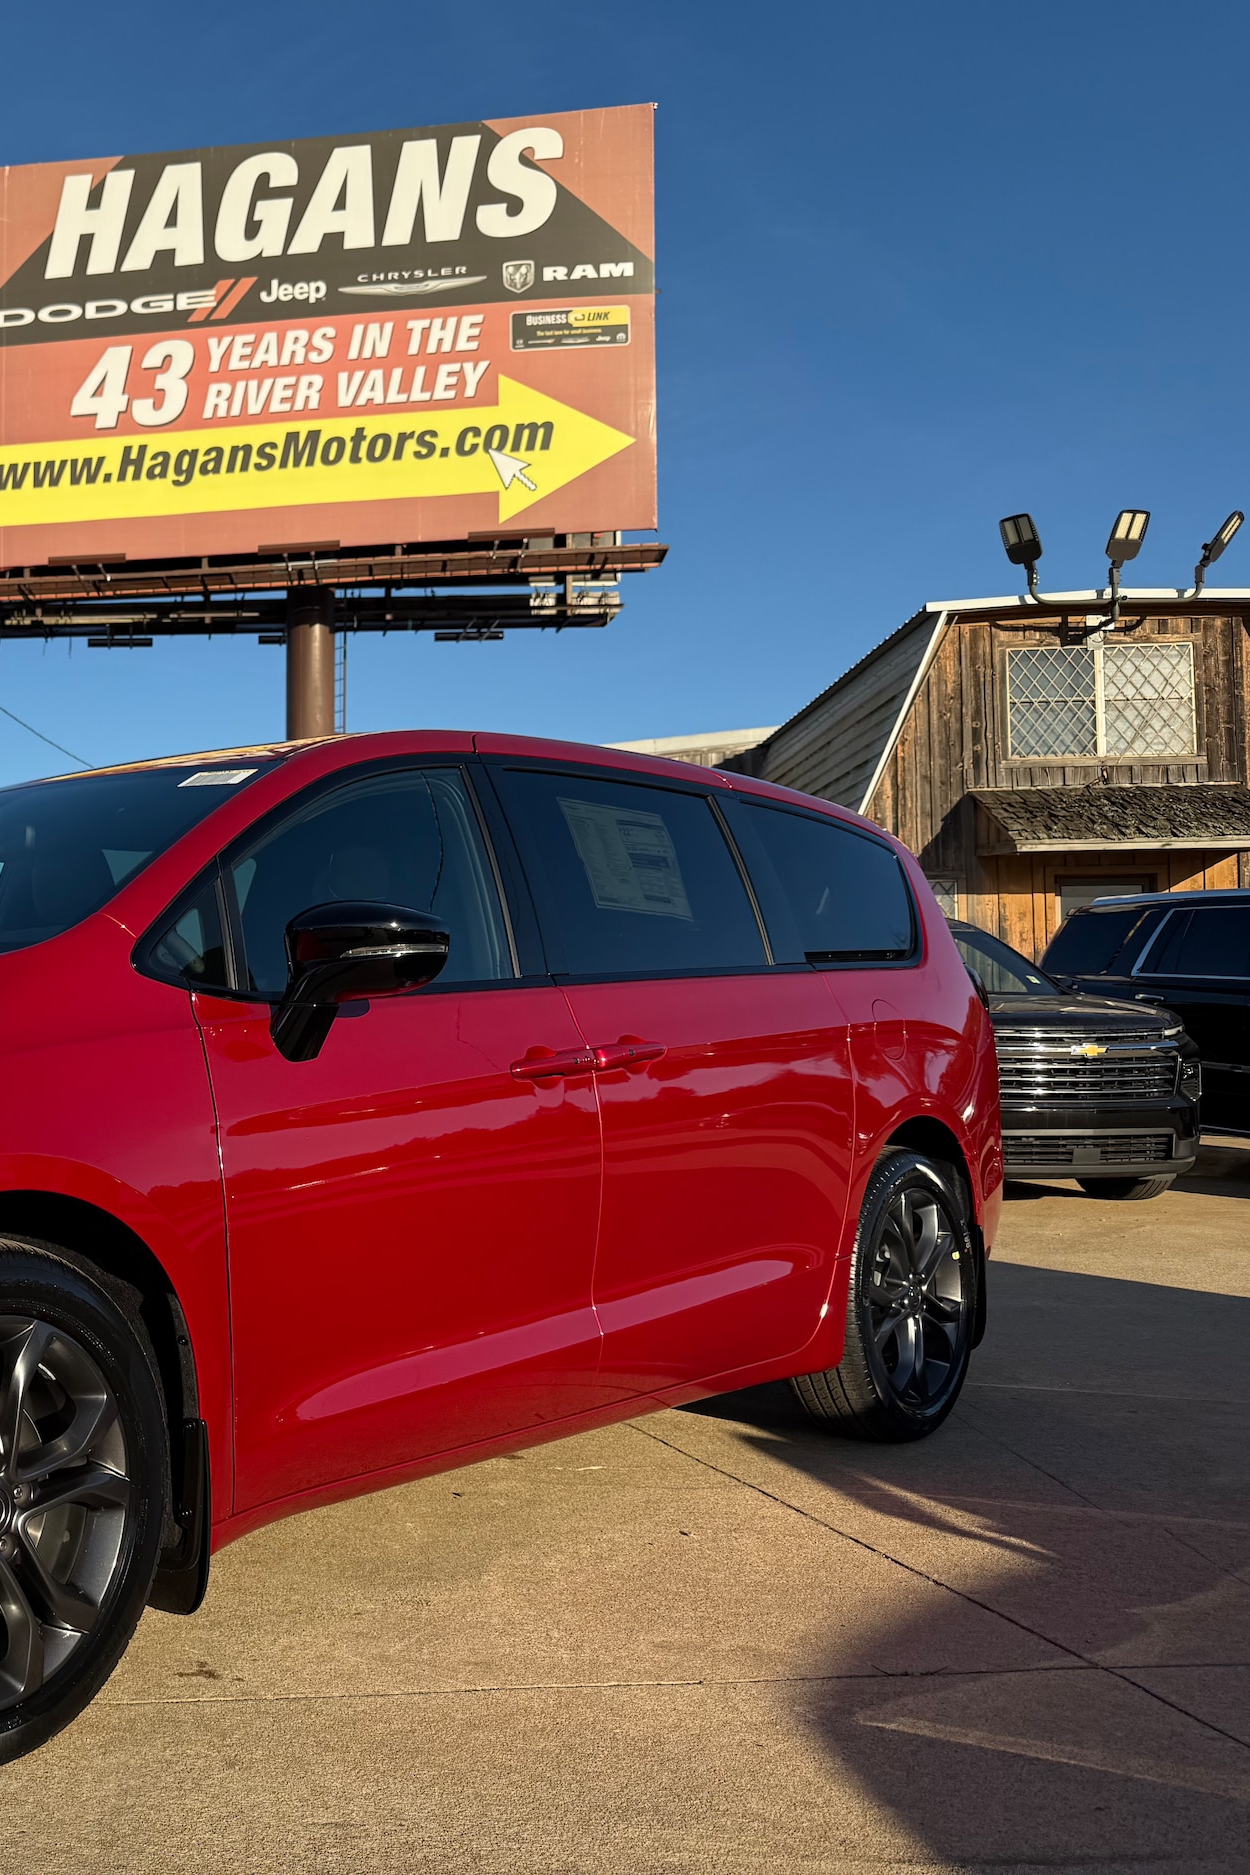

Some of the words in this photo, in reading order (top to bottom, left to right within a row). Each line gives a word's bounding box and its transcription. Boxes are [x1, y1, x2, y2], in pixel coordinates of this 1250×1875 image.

[43, 126, 565, 280] HAGANS
[357, 265, 468, 283] CHRYSLER
[542, 261, 634, 282] RAM
[259, 278, 328, 304] Jeep
[526, 313, 567, 326] BUSINESS
[587, 311, 610, 321] LINK
[206, 325, 337, 373] YEARS
[347, 321, 395, 360] IN
[406, 313, 486, 356] THE
[69, 338, 196, 430] 43
[202, 373, 324, 420] RIVER
[335, 359, 491, 408] VALLEY
